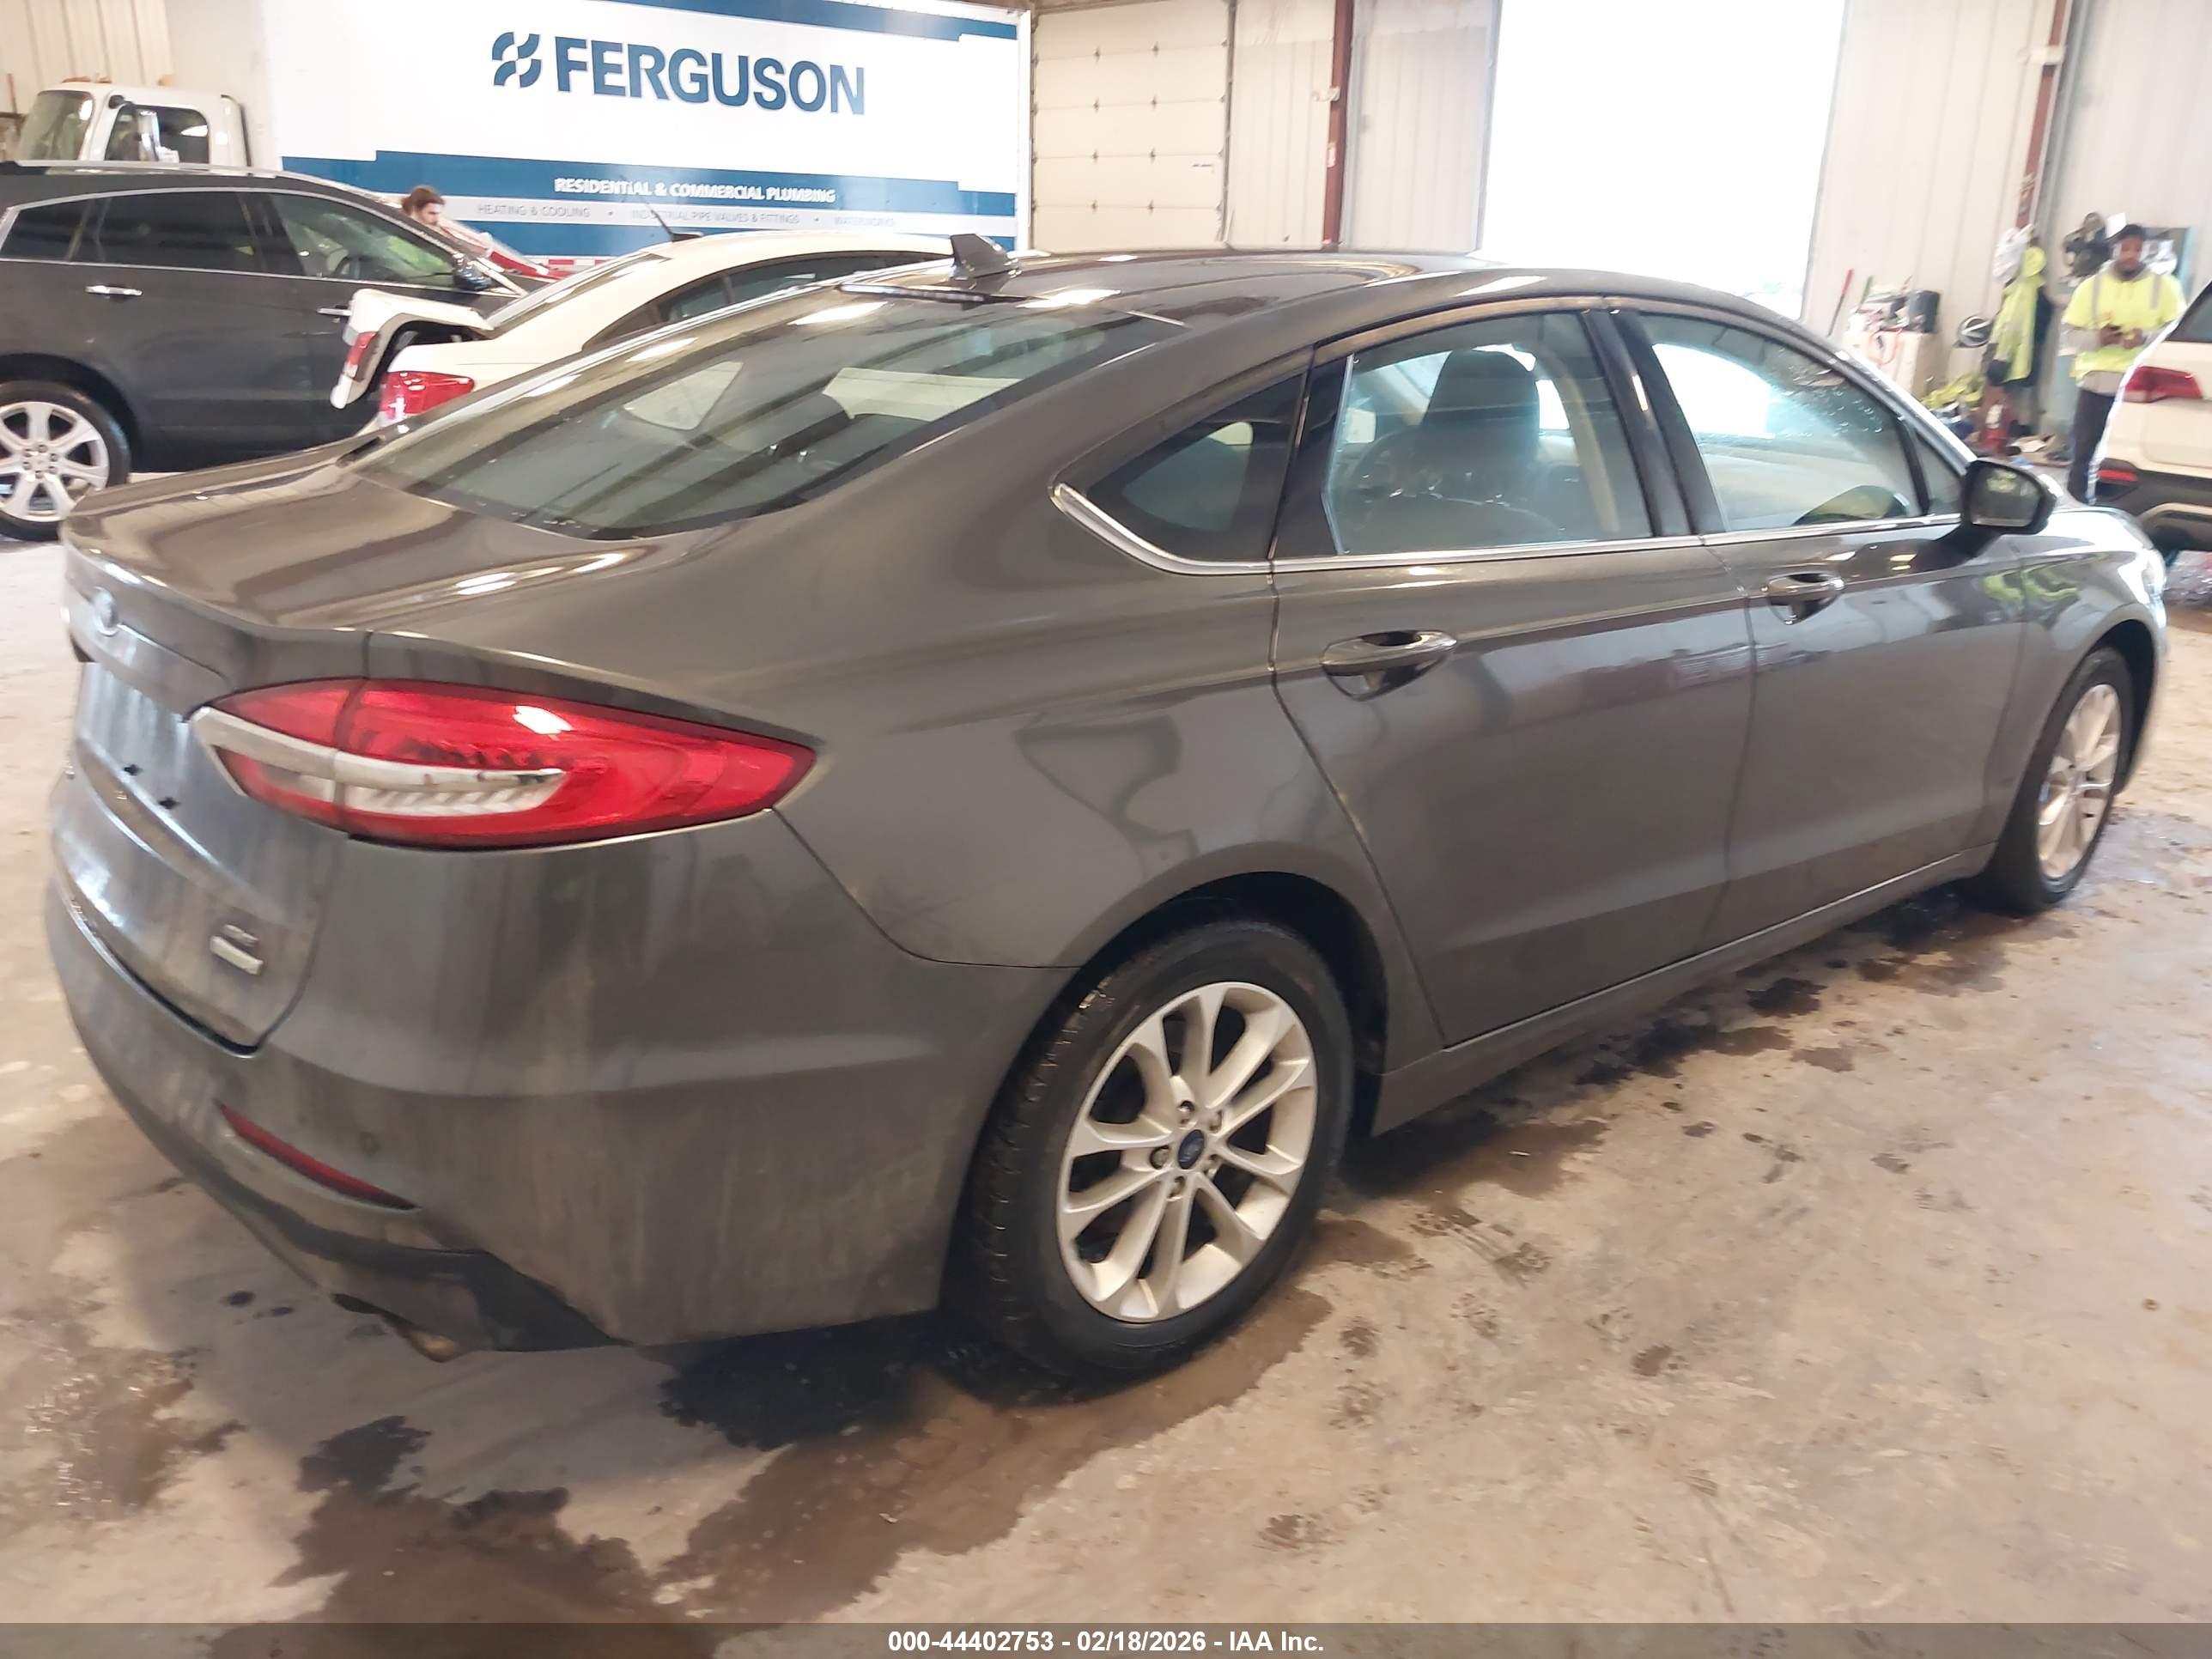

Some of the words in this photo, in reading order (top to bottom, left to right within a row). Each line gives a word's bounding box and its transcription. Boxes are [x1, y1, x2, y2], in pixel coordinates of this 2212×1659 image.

[555, 36, 865, 115] FERGUSON
[554, 178, 653, 196] RESIDENTIAL
[654, 182, 667, 197] &
[669, 183, 765, 200] COMMERCIAL
[766, 186, 836, 204] PLUMBING
[477, 204, 526, 216] HEATING
[542, 206, 592, 217] COOLING
